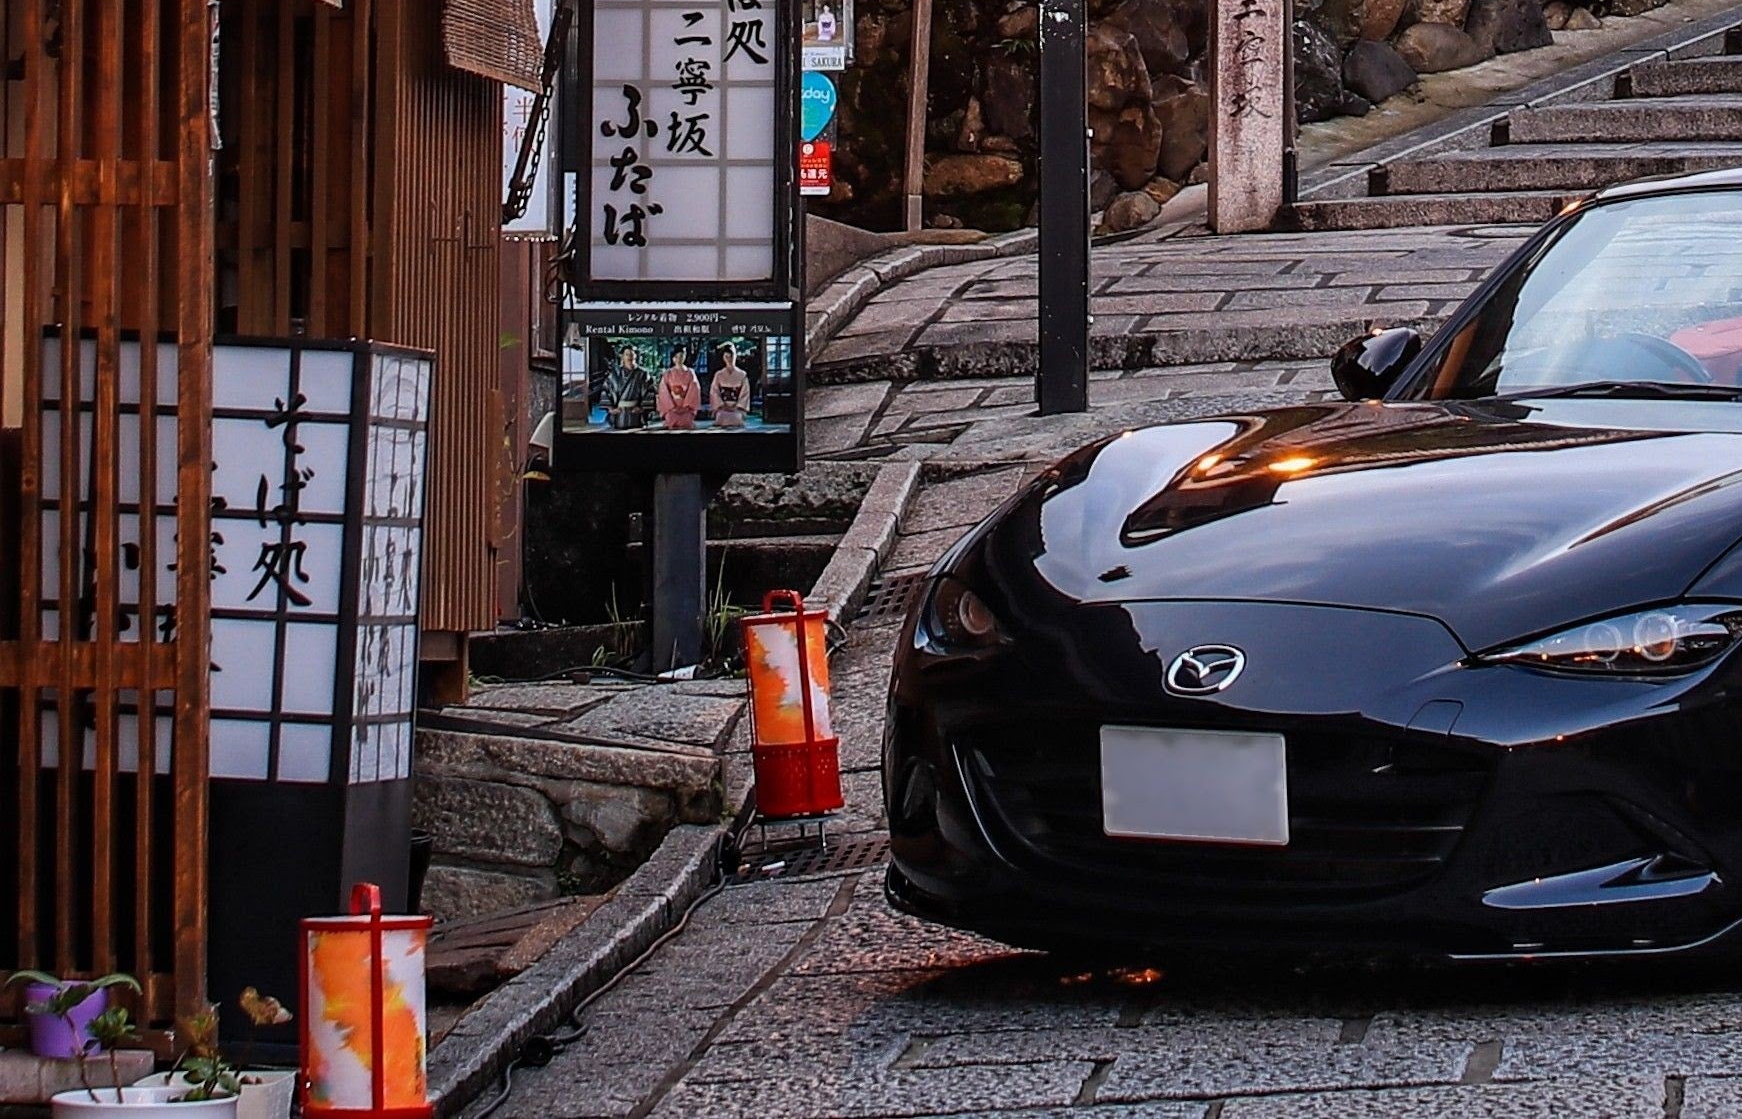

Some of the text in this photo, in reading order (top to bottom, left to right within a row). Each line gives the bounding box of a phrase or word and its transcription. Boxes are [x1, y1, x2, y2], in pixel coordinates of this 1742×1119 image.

[666, 12, 713, 157] 二寧坂
[811, 56, 843, 68] SAKURA
[600, 84, 664, 248] ふたば
[586, 325, 654, 334] Rental Kimono
[246, 392, 315, 608] そば処
